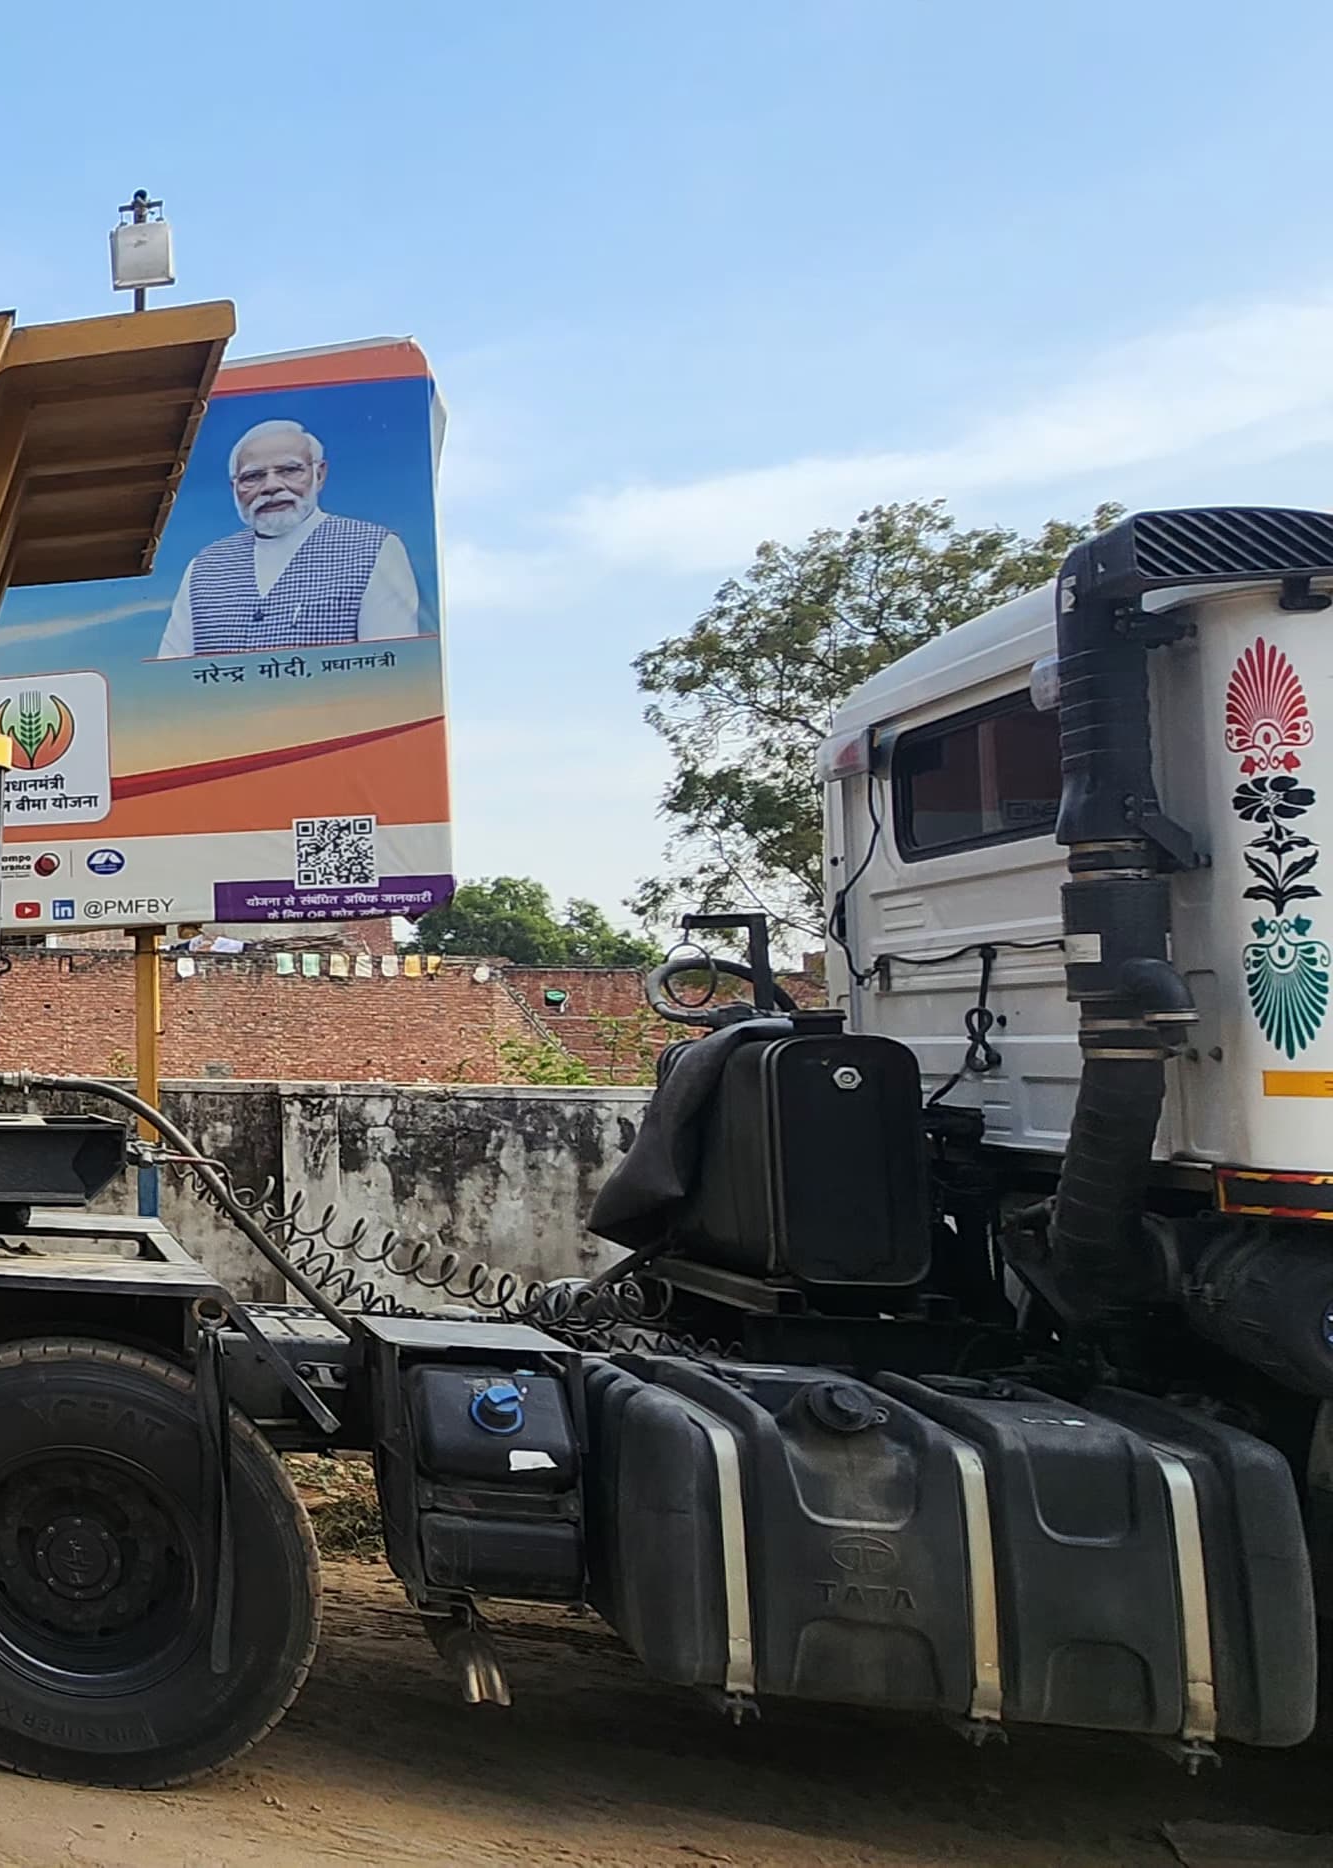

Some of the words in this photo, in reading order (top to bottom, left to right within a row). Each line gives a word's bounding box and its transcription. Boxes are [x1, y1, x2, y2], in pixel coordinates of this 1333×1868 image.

[192, 662, 245, 684] नरेन्द्र
[258, 656, 313, 679] मोदी,
[15, 794, 47, 812] बीमा
[51, 792, 99, 809] योजना
[83, 898, 174, 919] @PMFBY
[813, 1579, 917, 1609] TATA
